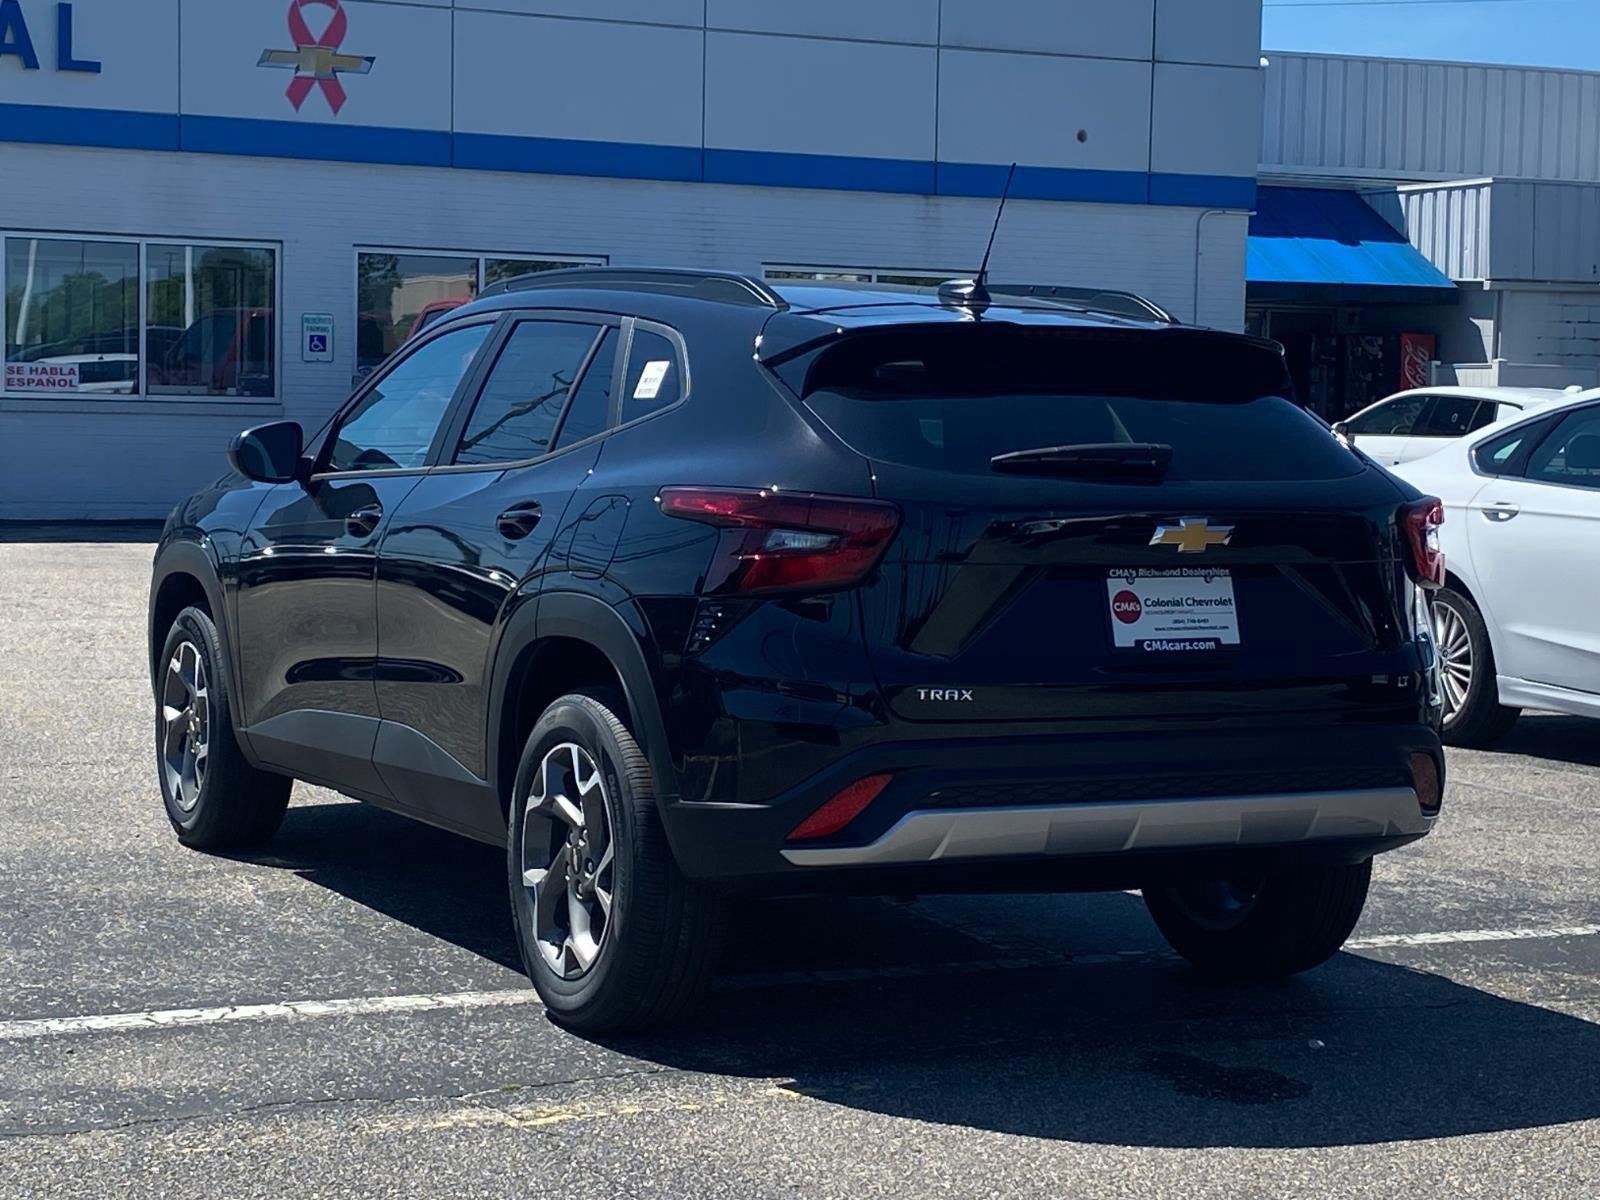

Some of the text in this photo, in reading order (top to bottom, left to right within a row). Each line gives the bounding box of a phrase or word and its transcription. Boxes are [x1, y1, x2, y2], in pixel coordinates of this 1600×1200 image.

[7, 366, 77, 376] SE HABLA
[7, 376, 78, 388] ESPAÑOL
[1138, 568, 1180, 577] Richmond
[1182, 567, 1230, 577] Dealerships
[1114, 602, 1141, 611] CMA's
[1144, 596, 1233, 607] Colonial Chevrolet
[1143, 640, 1216, 651] CMAcars.com
[1397, 675, 1409, 687] LT
[917, 689, 973, 700] TRAX
